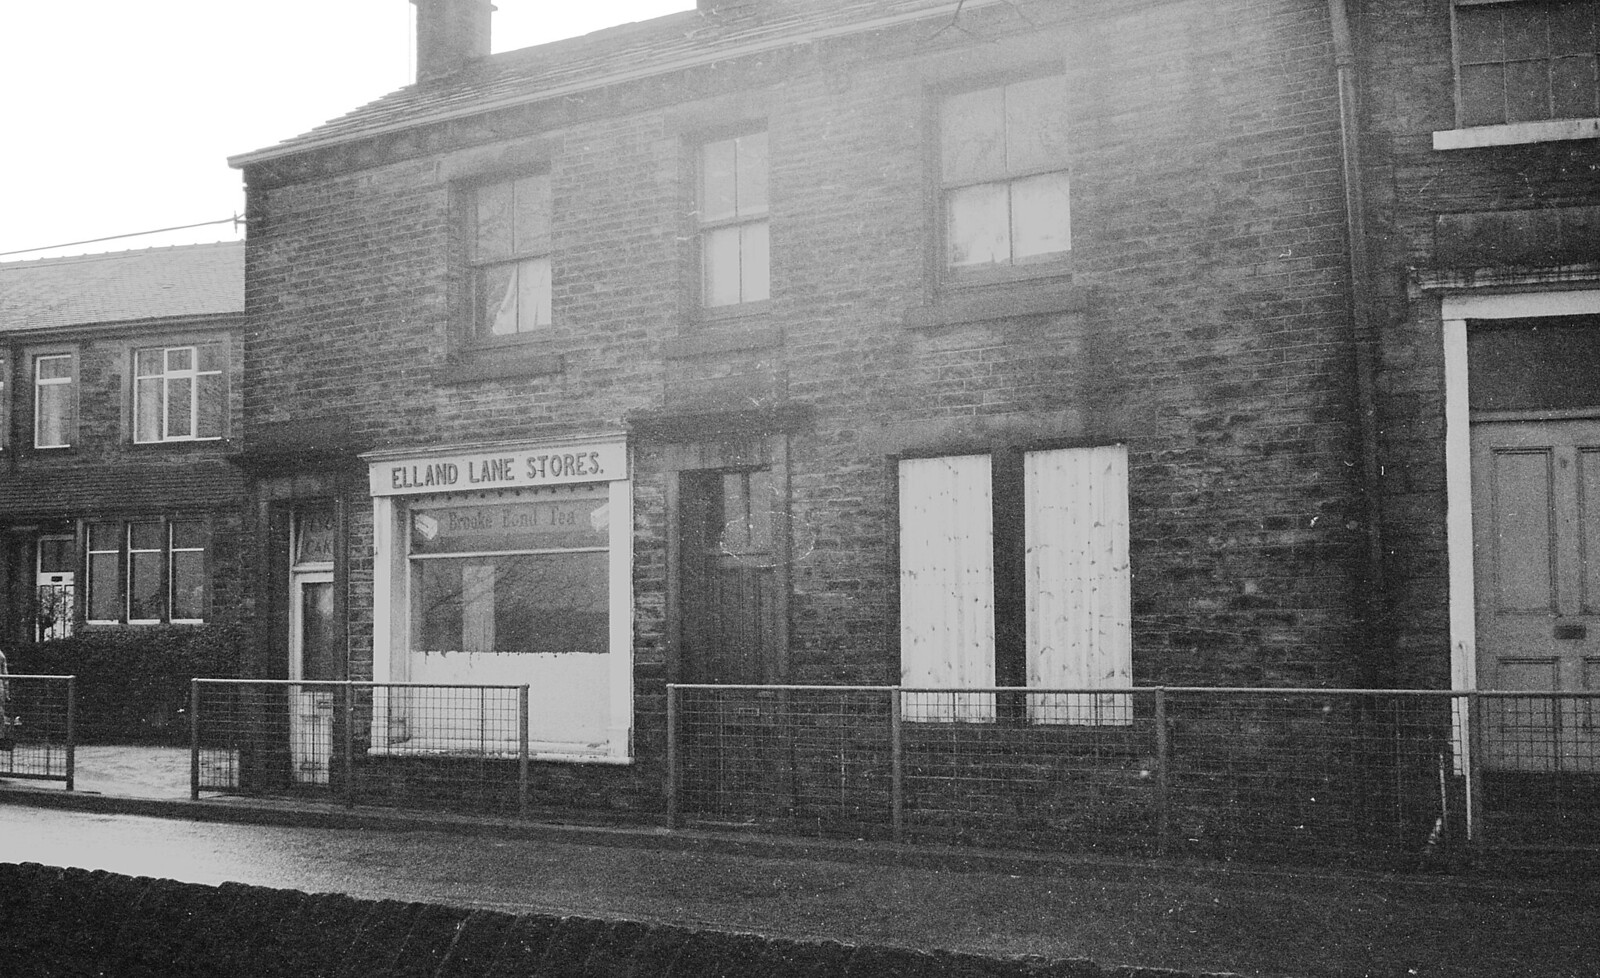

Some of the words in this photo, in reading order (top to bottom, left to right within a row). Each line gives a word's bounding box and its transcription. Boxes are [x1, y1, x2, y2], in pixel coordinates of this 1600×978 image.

[391, 463, 459, 489] ELLAND
[468, 458, 515, 483] LANE
[526, 451, 604, 479] STORES.
[449, 511, 493, 531] Brooke
[502, 508, 537, 528] Bond
[550, 505, 577, 526] Tea
